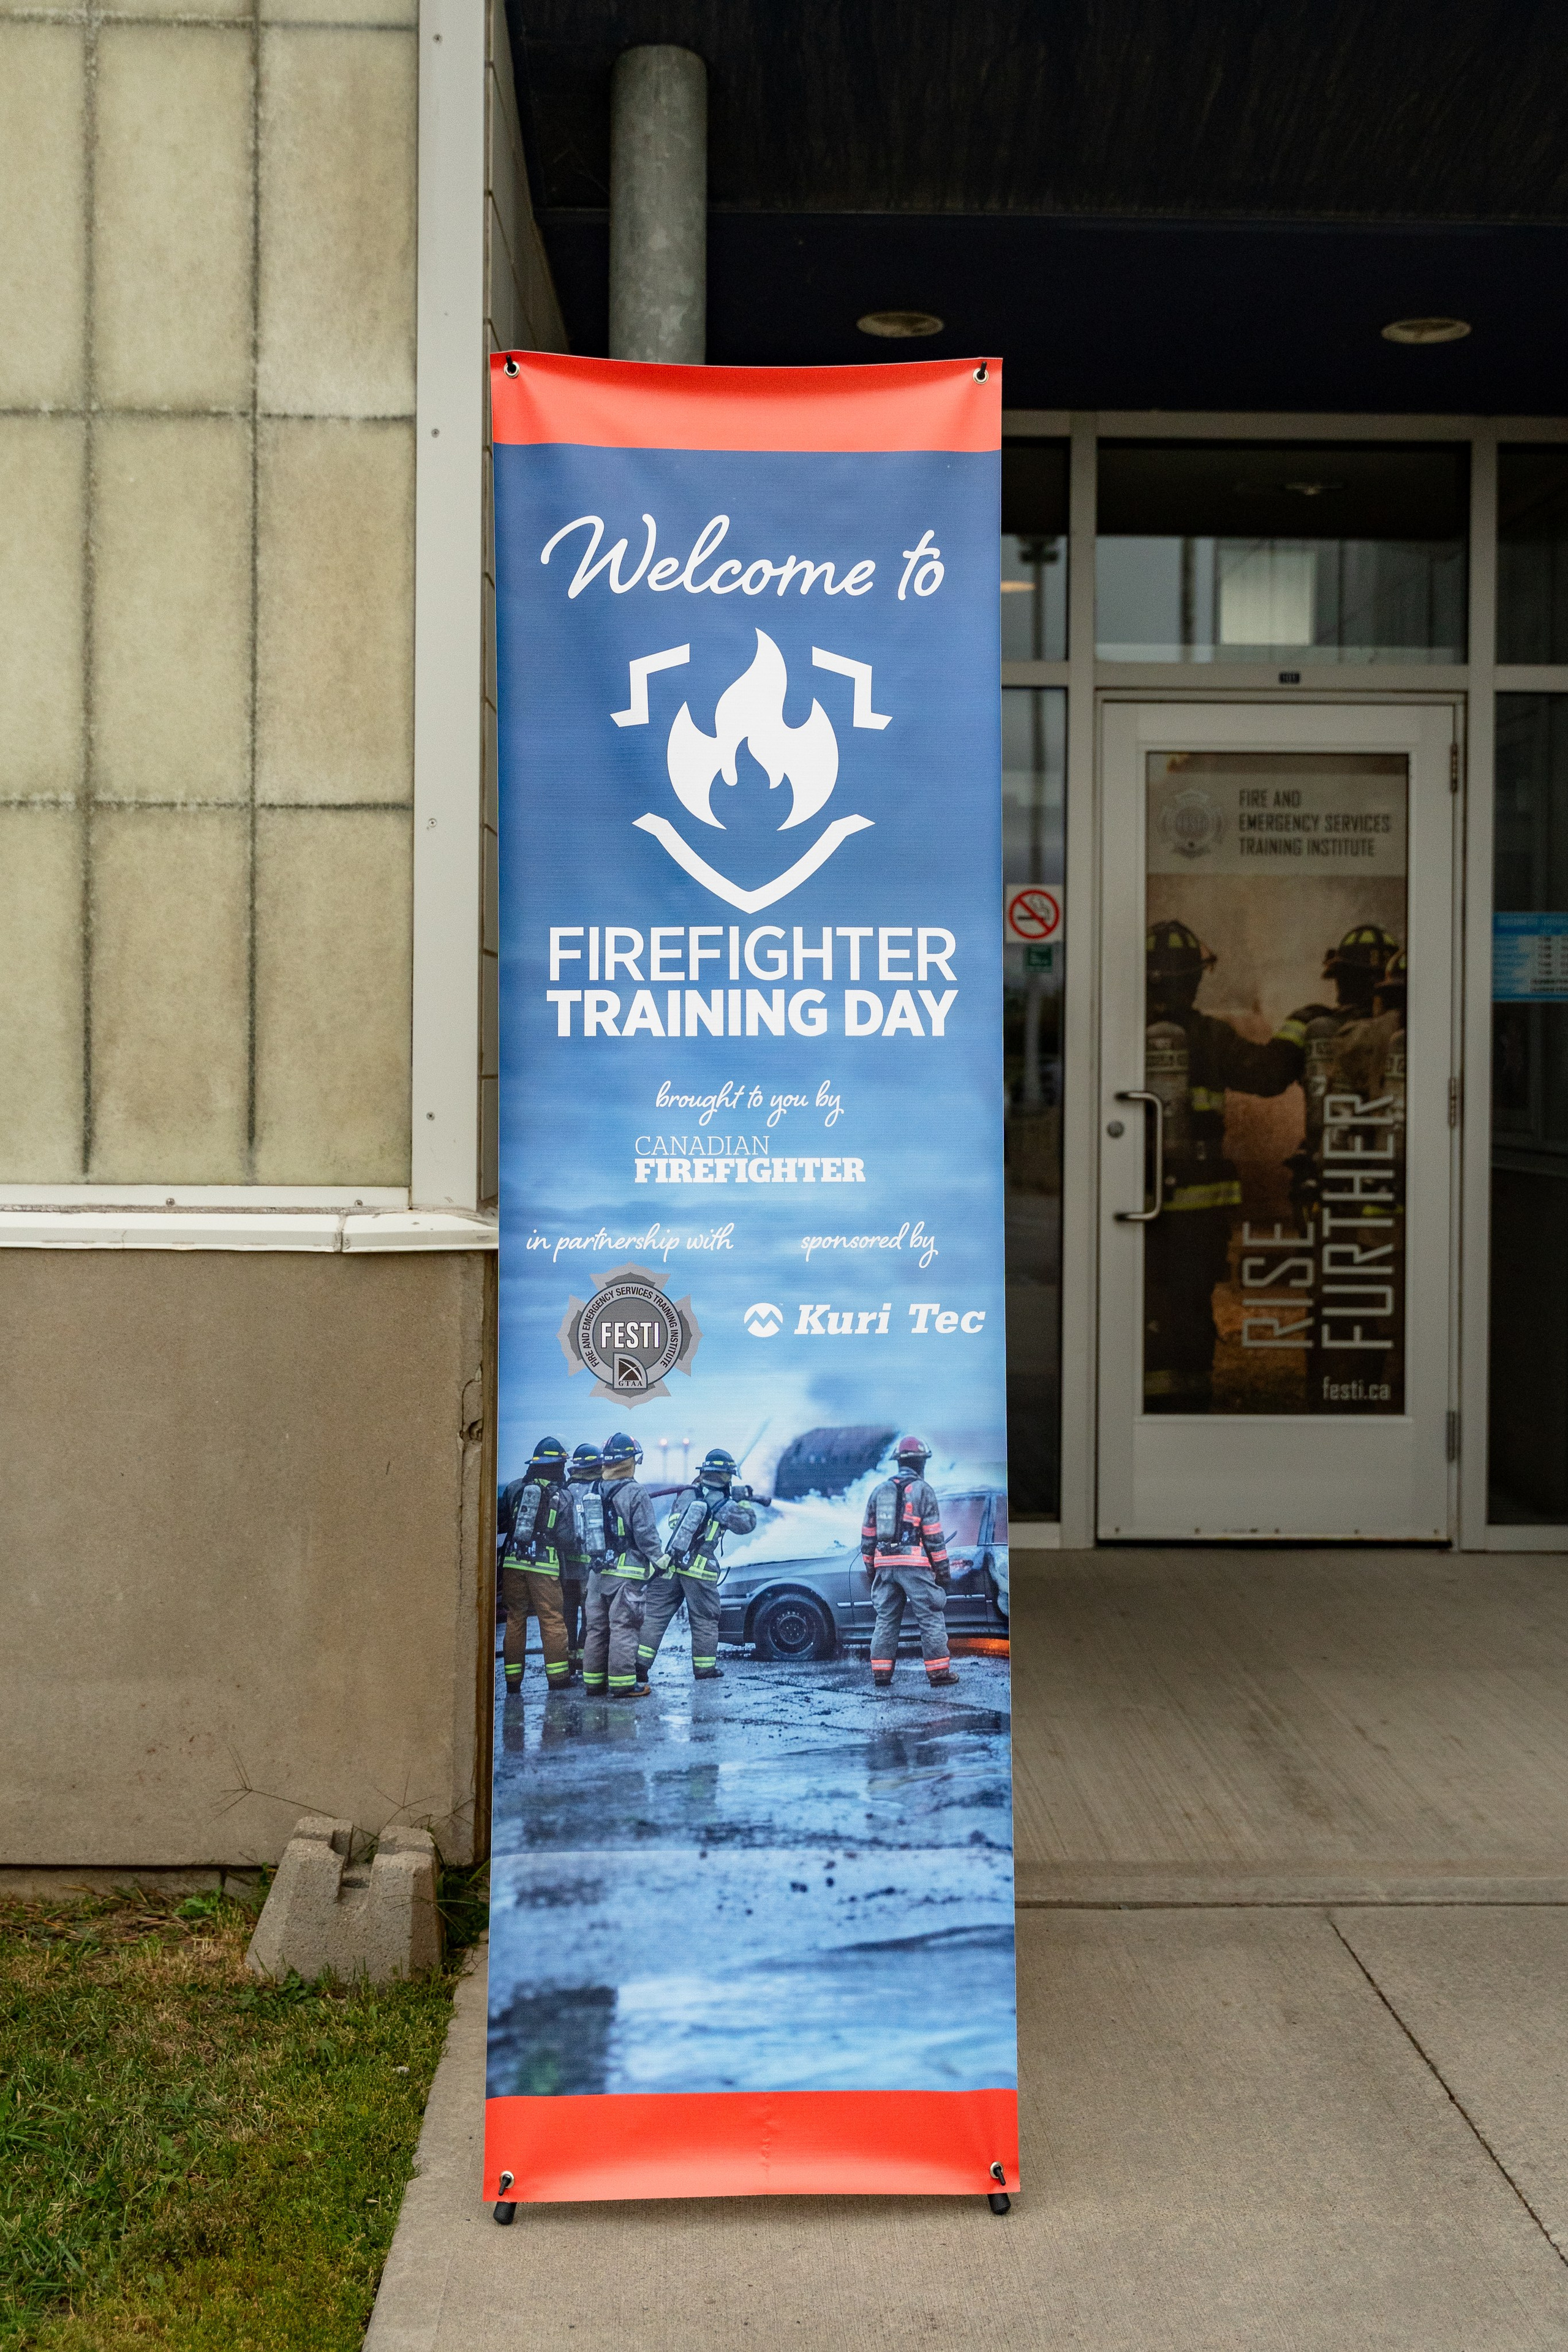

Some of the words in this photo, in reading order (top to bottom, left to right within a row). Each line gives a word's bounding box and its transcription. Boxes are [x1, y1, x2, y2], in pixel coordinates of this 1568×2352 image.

[540, 513, 875, 600] Welcome
[897, 529, 945, 601] to
[1239, 789, 1267, 808] FIRE
[1273, 790, 1301, 808] AND
[1239, 813, 1319, 832] EMERGENCY
[1325, 813, 1391, 833] SERVICES
[1240, 837, 1302, 856] TRAINING
[1307, 838, 1375, 856] INSTITUTE
[549, 925, 957, 981] FIREFIGHTER
[546, 989, 828, 1037] TRAINING
[845, 989, 959, 1037] DAY
[655, 1080, 745, 1126] brought
[747, 1085, 764, 1109] to
[766, 1094, 809, 1128] you
[816, 1080, 844, 1128] by
[635, 1136, 769, 1156] CANADIAN
[635, 1156, 866, 1183] FIREFIGHTER
[1322, 1093, 1395, 1349] FURTHER
[526, 1229, 551, 1250] in
[553, 1223, 680, 1263] partnership
[687, 1223, 735, 1251] with
[801, 1222, 910, 1262] sponsored
[910, 1221, 938, 1268] by
[616, 1286, 654, 1299] SERVICES
[1242, 1221, 1314, 1348] RISE
[582, 1290, 614, 1331] EMERGENCY
[653, 1294, 677, 1328] TRAINING
[794, 1303, 892, 1335] Kuri
[908, 1303, 986, 1335] Tec
[582, 1333, 591, 1349] AND
[601, 1321, 660, 1349] FESTI
[660, 1329, 679, 1368] INSTITUTE
[585, 1349, 600, 1368] FIRE
[1323, 1376, 1390, 1401] festi.ca
